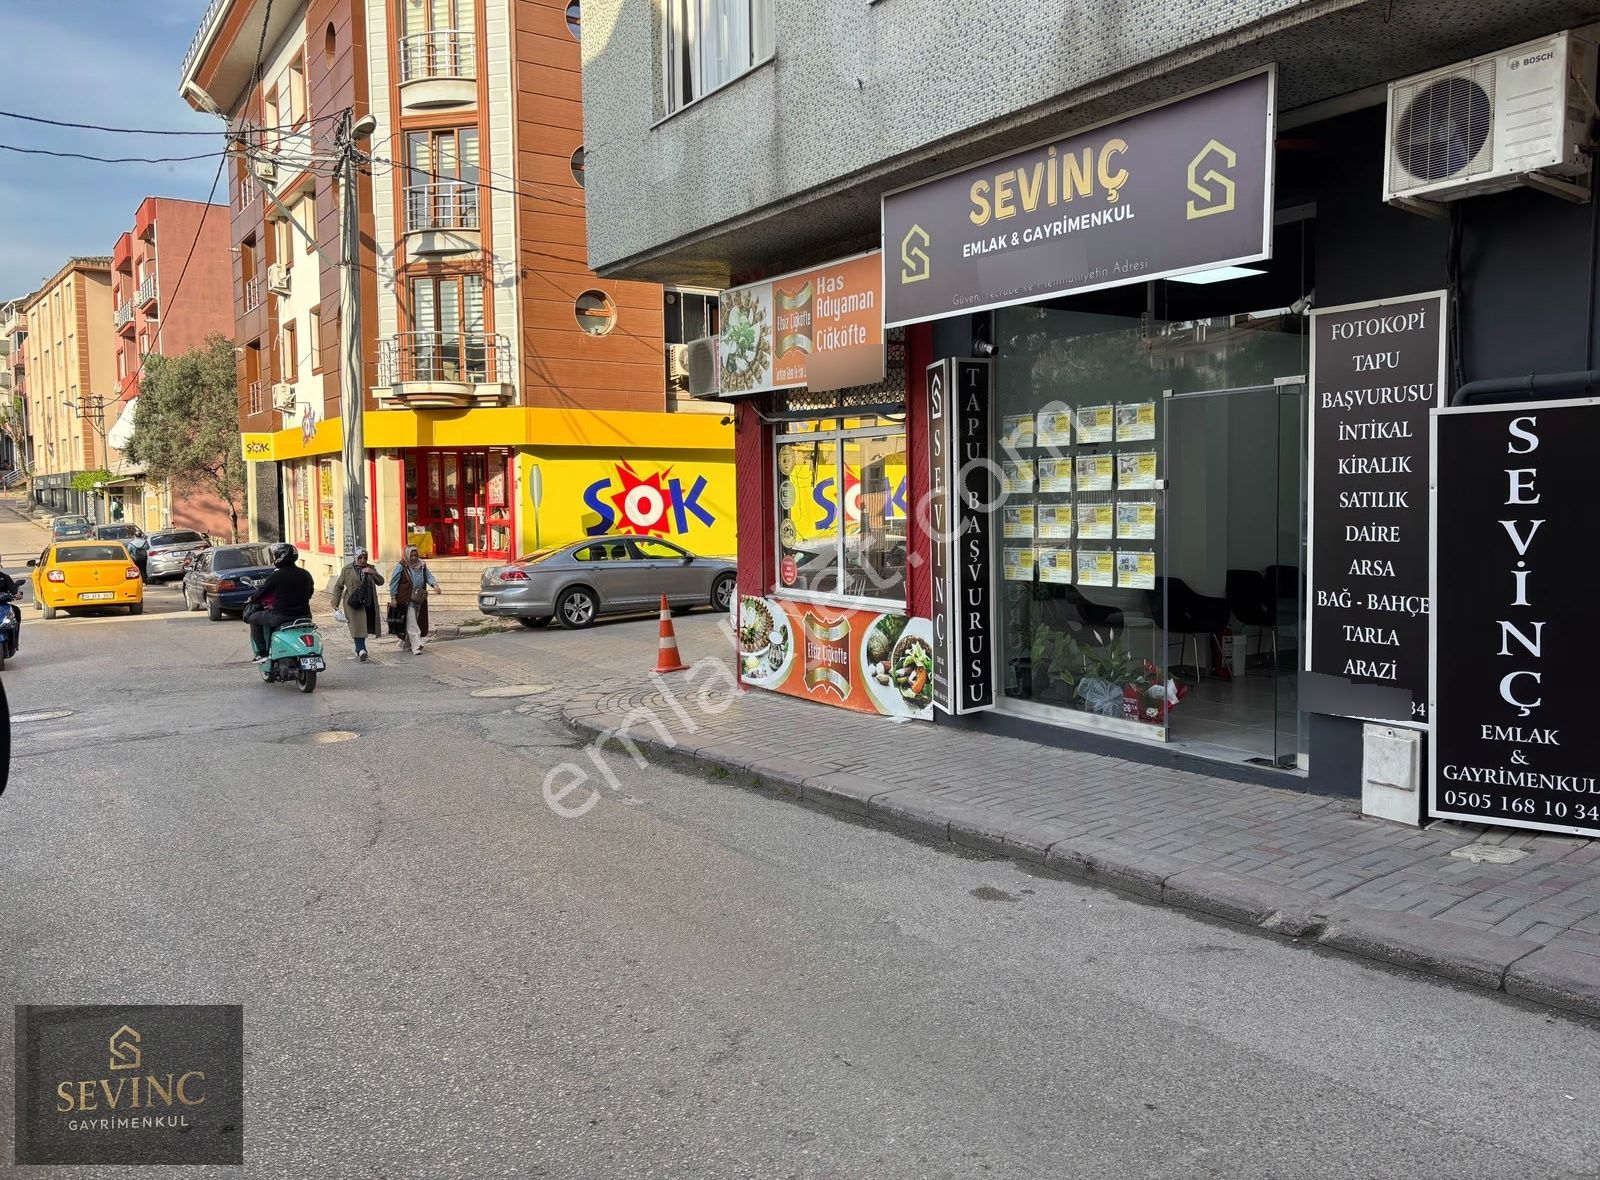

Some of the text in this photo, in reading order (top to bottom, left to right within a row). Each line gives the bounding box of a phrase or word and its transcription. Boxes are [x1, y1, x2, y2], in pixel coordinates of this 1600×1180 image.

[1523, 51, 1554, 66] BOSCH
[968, 137, 1130, 227] SEVİNÇ
[962, 203, 1136, 258] EMLAK & GAYRİMENKUL
[1112, 257, 1149, 275] Adresi
[816, 274, 845, 296] Has
[816, 290, 875, 321] Adıyaman
[1330, 307, 1426, 341] FOTOKOPİ
[816, 323, 867, 353] Çiğköfte
[1352, 350, 1401, 372] TAPU
[1320, 382, 1434, 411] BAŞVURUSU
[1337, 419, 1413, 442] İNTİKAL
[1337, 454, 1413, 475] KİRALIK
[1338, 491, 1410, 509] SATILIK
[966, 367, 984, 702] TAPU BAŞVURUSU
[1344, 521, 1401, 543] DAİRE
[1348, 559, 1396, 577] ARSA
[1496, 416, 1547, 717] SEVİNÇ
[1316, 588, 1352, 609] BAĞ
[1366, 593, 1430, 618] BAHÇE
[1342, 625, 1400, 647] TARLA
[1343, 658, 1398, 681] ARAZİ
[1480, 724, 1561, 746] EMLAK
[1510, 749, 1530, 766] &
[1443, 764, 1600, 795] GAYRİMENKUL
[1444, 790, 1600, 822] 0505 168 10 34
